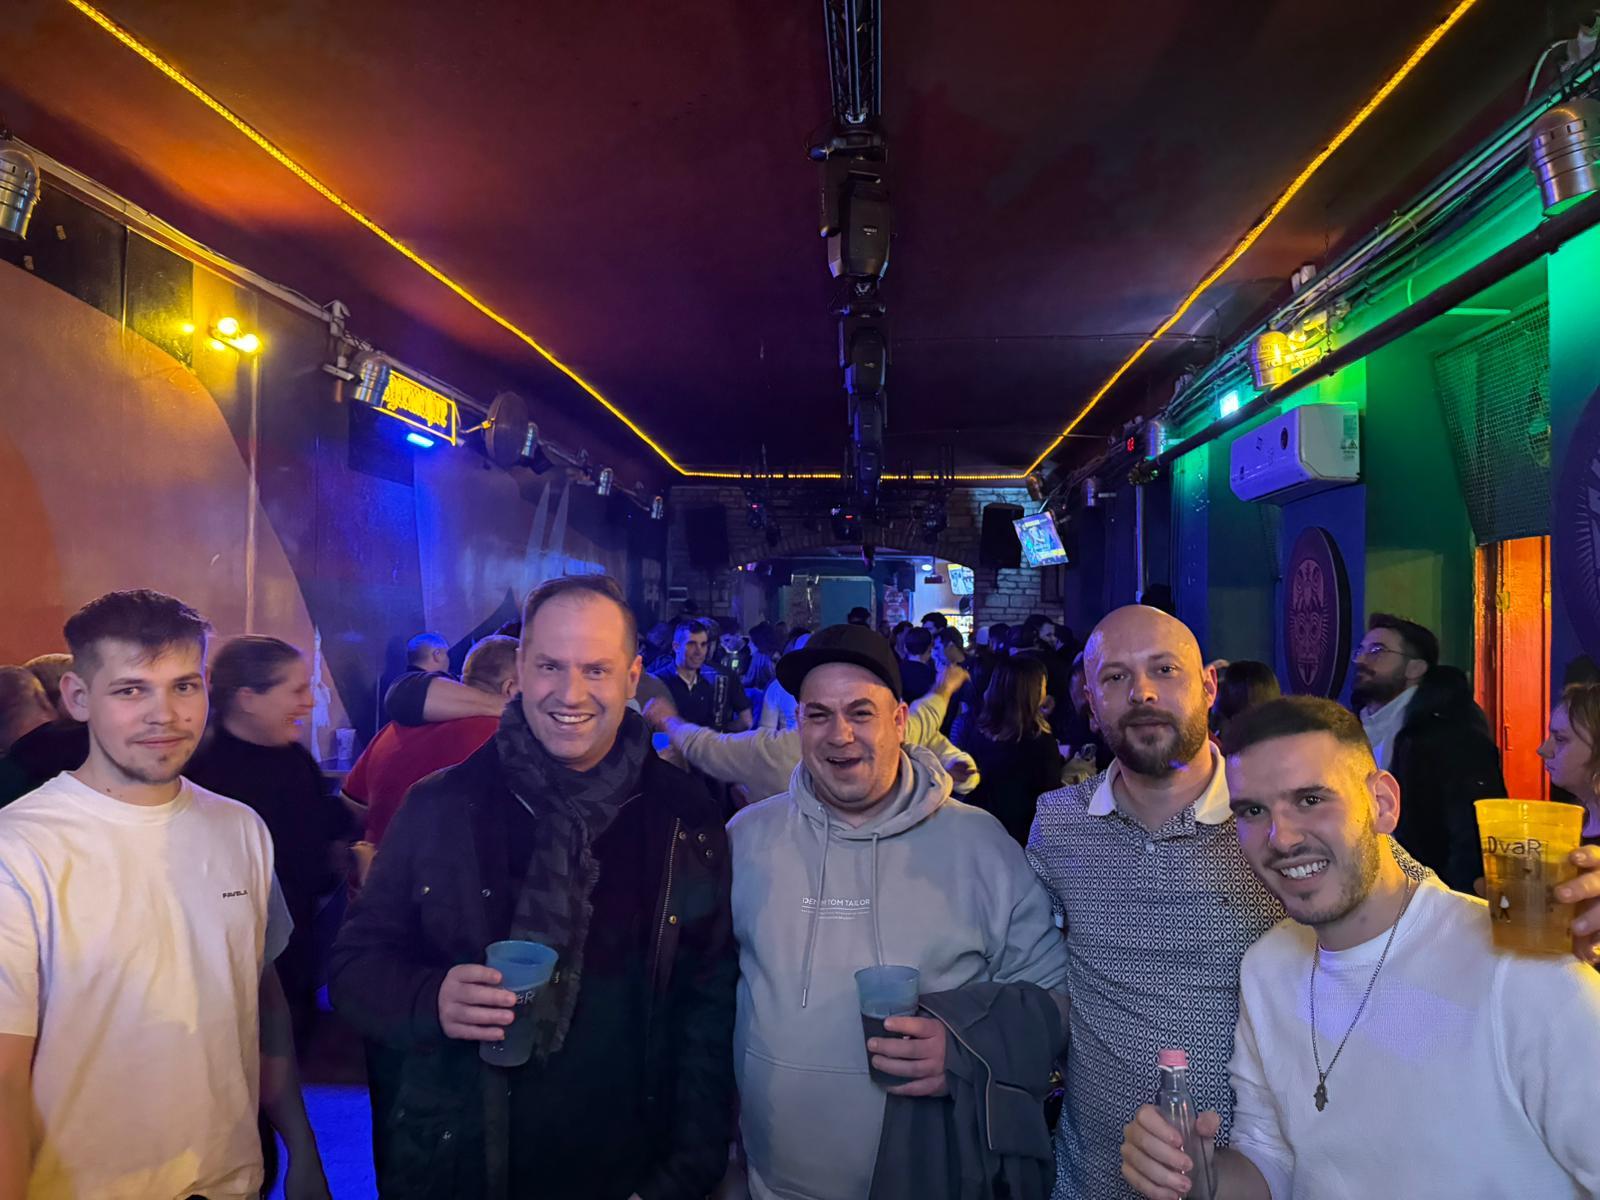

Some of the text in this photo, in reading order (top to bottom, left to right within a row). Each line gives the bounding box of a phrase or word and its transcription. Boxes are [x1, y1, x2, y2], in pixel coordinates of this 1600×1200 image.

[802, 897, 871, 907] DENM TOM TAILOR
